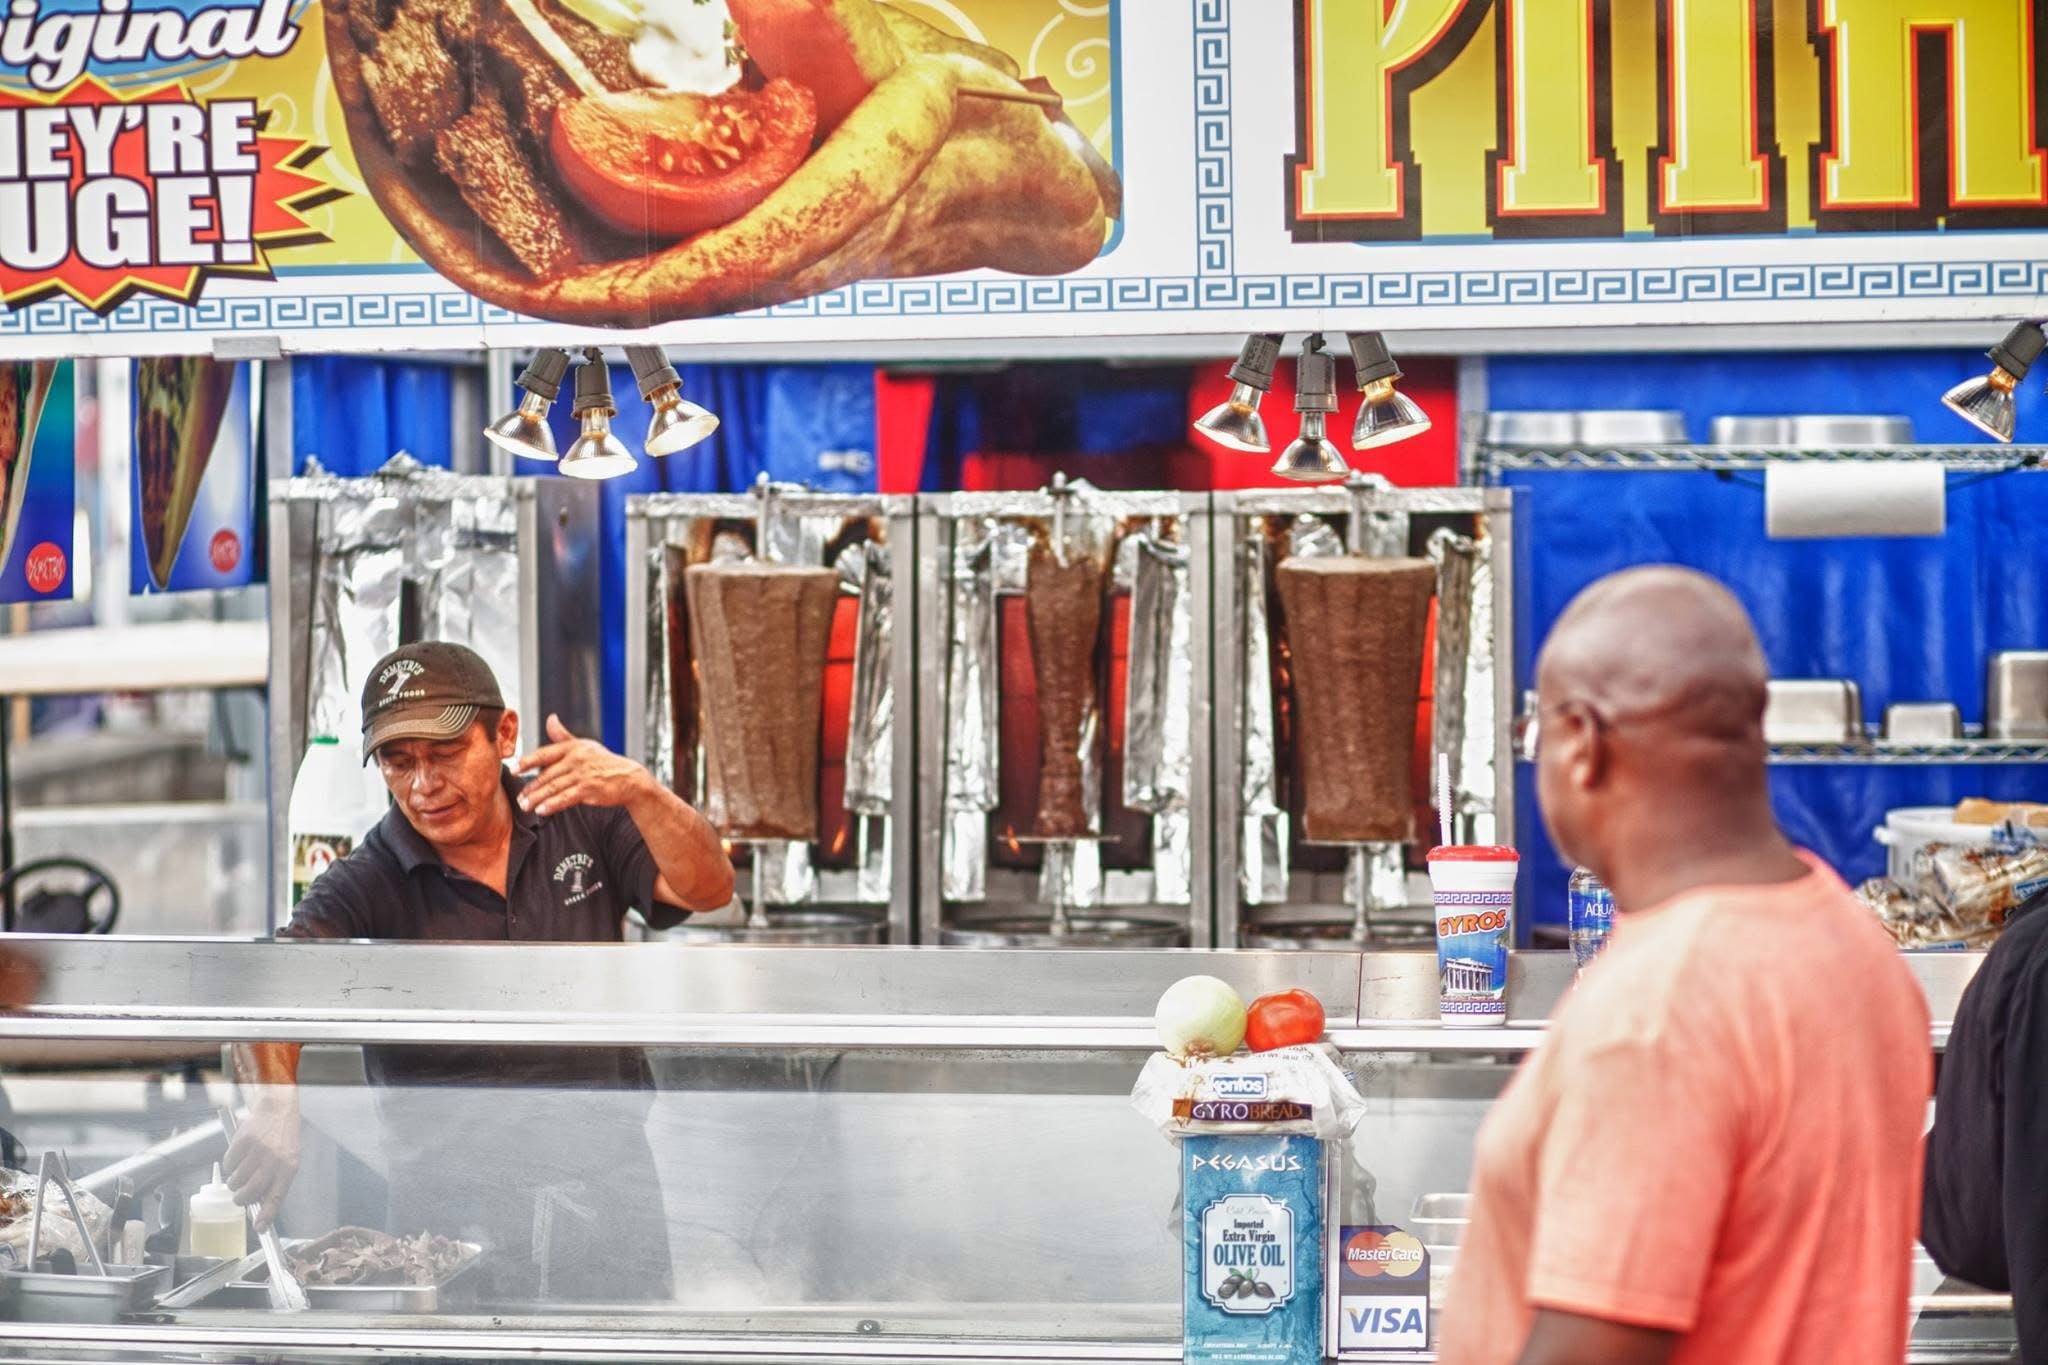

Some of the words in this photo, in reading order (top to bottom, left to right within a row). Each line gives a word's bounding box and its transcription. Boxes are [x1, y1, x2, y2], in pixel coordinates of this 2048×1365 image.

[0, 0, 300, 91] iginal
[553, 853, 594, 882] DEMETRI'S
[1584, 902, 1618, 918] AQUA
[1438, 909, 1507, 937] GYROS
[1192, 1154, 1303, 1171] PEGASUS
[1234, 1219, 1264, 1229] Imported
[1223, 1229, 1246, 1241] Extra
[1249, 1229, 1275, 1243] Virgin
[1214, 1244, 1257, 1266] OLIVE
[1260, 1244, 1285, 1266] OIL
[1348, 1247, 1422, 1261] MasterCard
[1344, 1307, 1424, 1334] VISA
